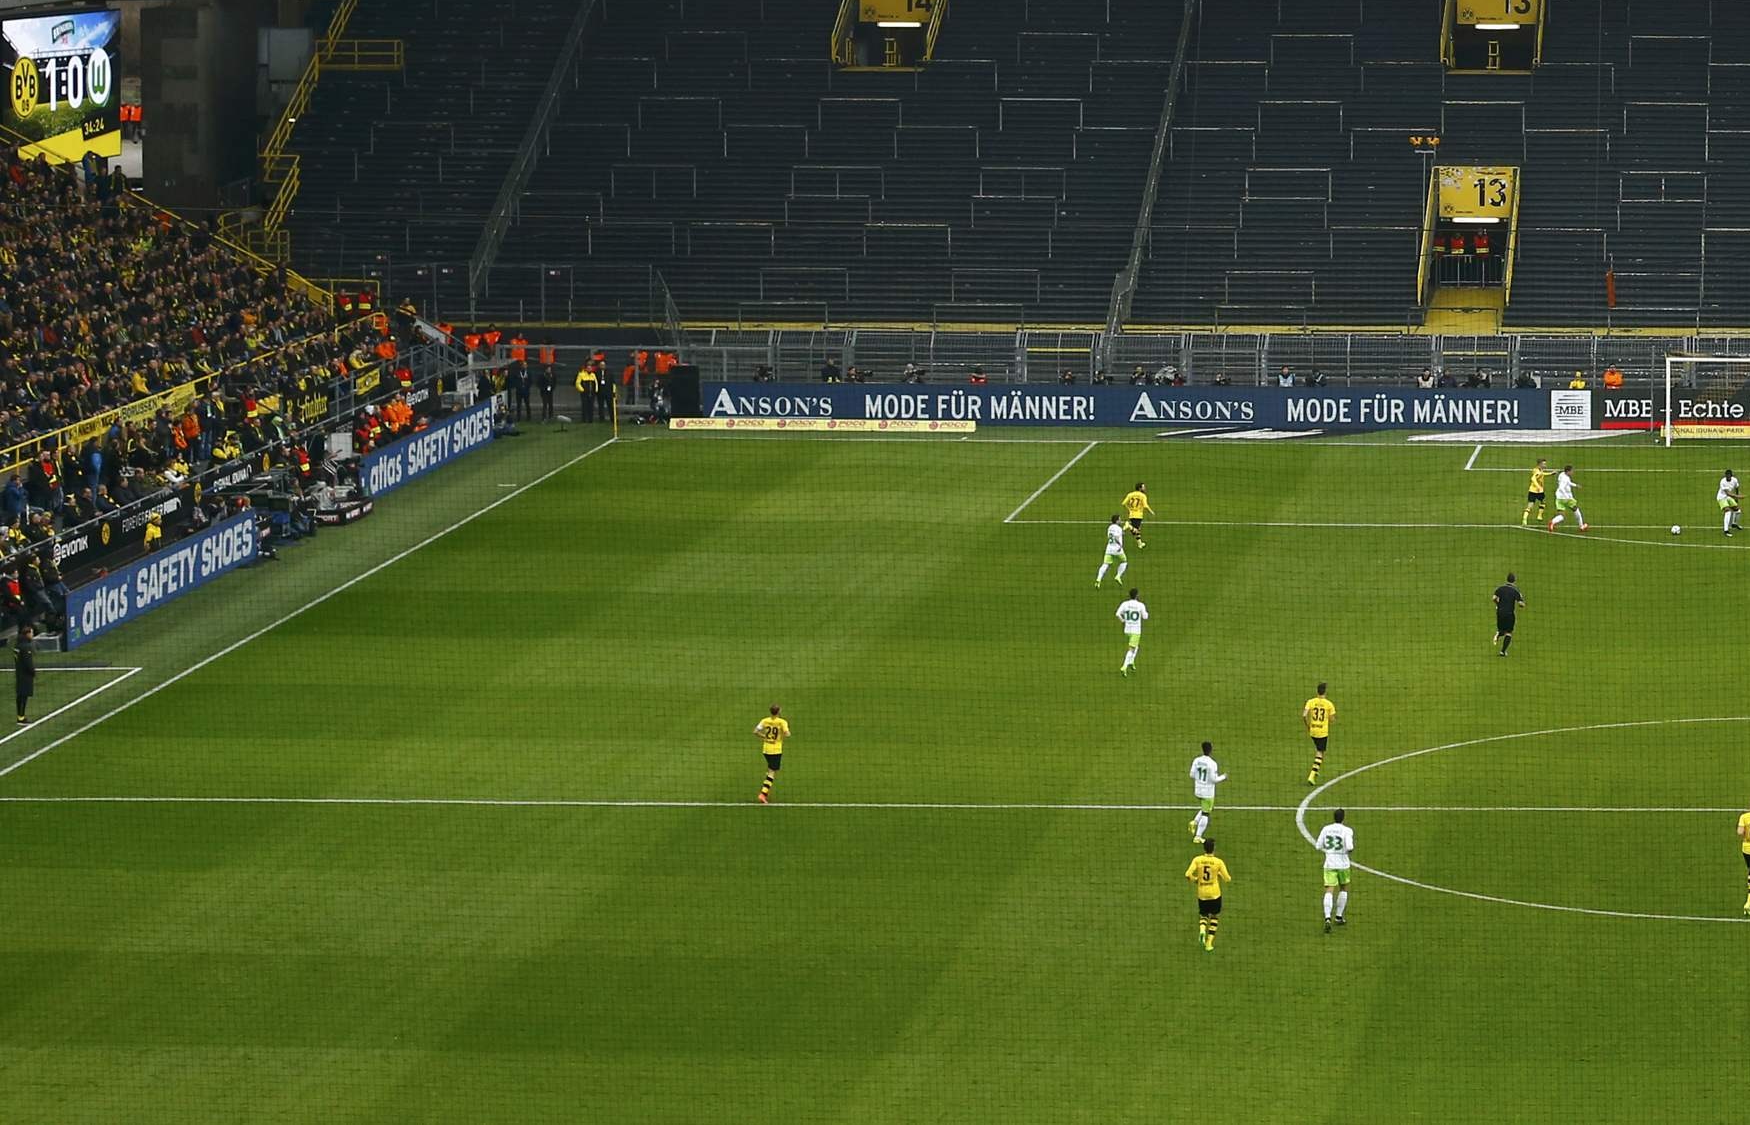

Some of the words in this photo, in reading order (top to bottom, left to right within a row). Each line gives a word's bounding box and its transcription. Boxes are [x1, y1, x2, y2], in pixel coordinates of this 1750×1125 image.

[16, 63, 36, 99] BVB
[83, 117, 105, 137] 34:24
[1473, 178, 1507, 207] 13
[710, 388, 833, 418] ANSON'S
[865, 394, 929, 420] MODE
[937, 391, 982, 420] FÜR
[990, 391, 1096, 421] MÄNNER!
[1129, 391, 1255, 423] ANSON'S
[1287, 397, 1352, 423] MODE
[1359, 394, 1405, 423] FÜR
[1413, 394, 1520, 424] MÄNNER!
[1559, 406, 1584, 416] MBE
[1604, 399, 1652, 418] MBE
[1679, 399, 1744, 418] Echte
[370, 455, 403, 495] atlas
[408, 425, 450, 476] SAFETY
[453, 406, 491, 454] SHOES
[82, 582, 128, 636] atlas
[136, 544, 198, 608] SAFETY
[201, 519, 253, 577] SHOES
[1124, 610, 1140, 622] 10
[1312, 707, 1325, 722] 33
[765, 726, 778, 741] 29
[1325, 835, 1343, 850] 33
[1203, 865, 1211, 881] 5
